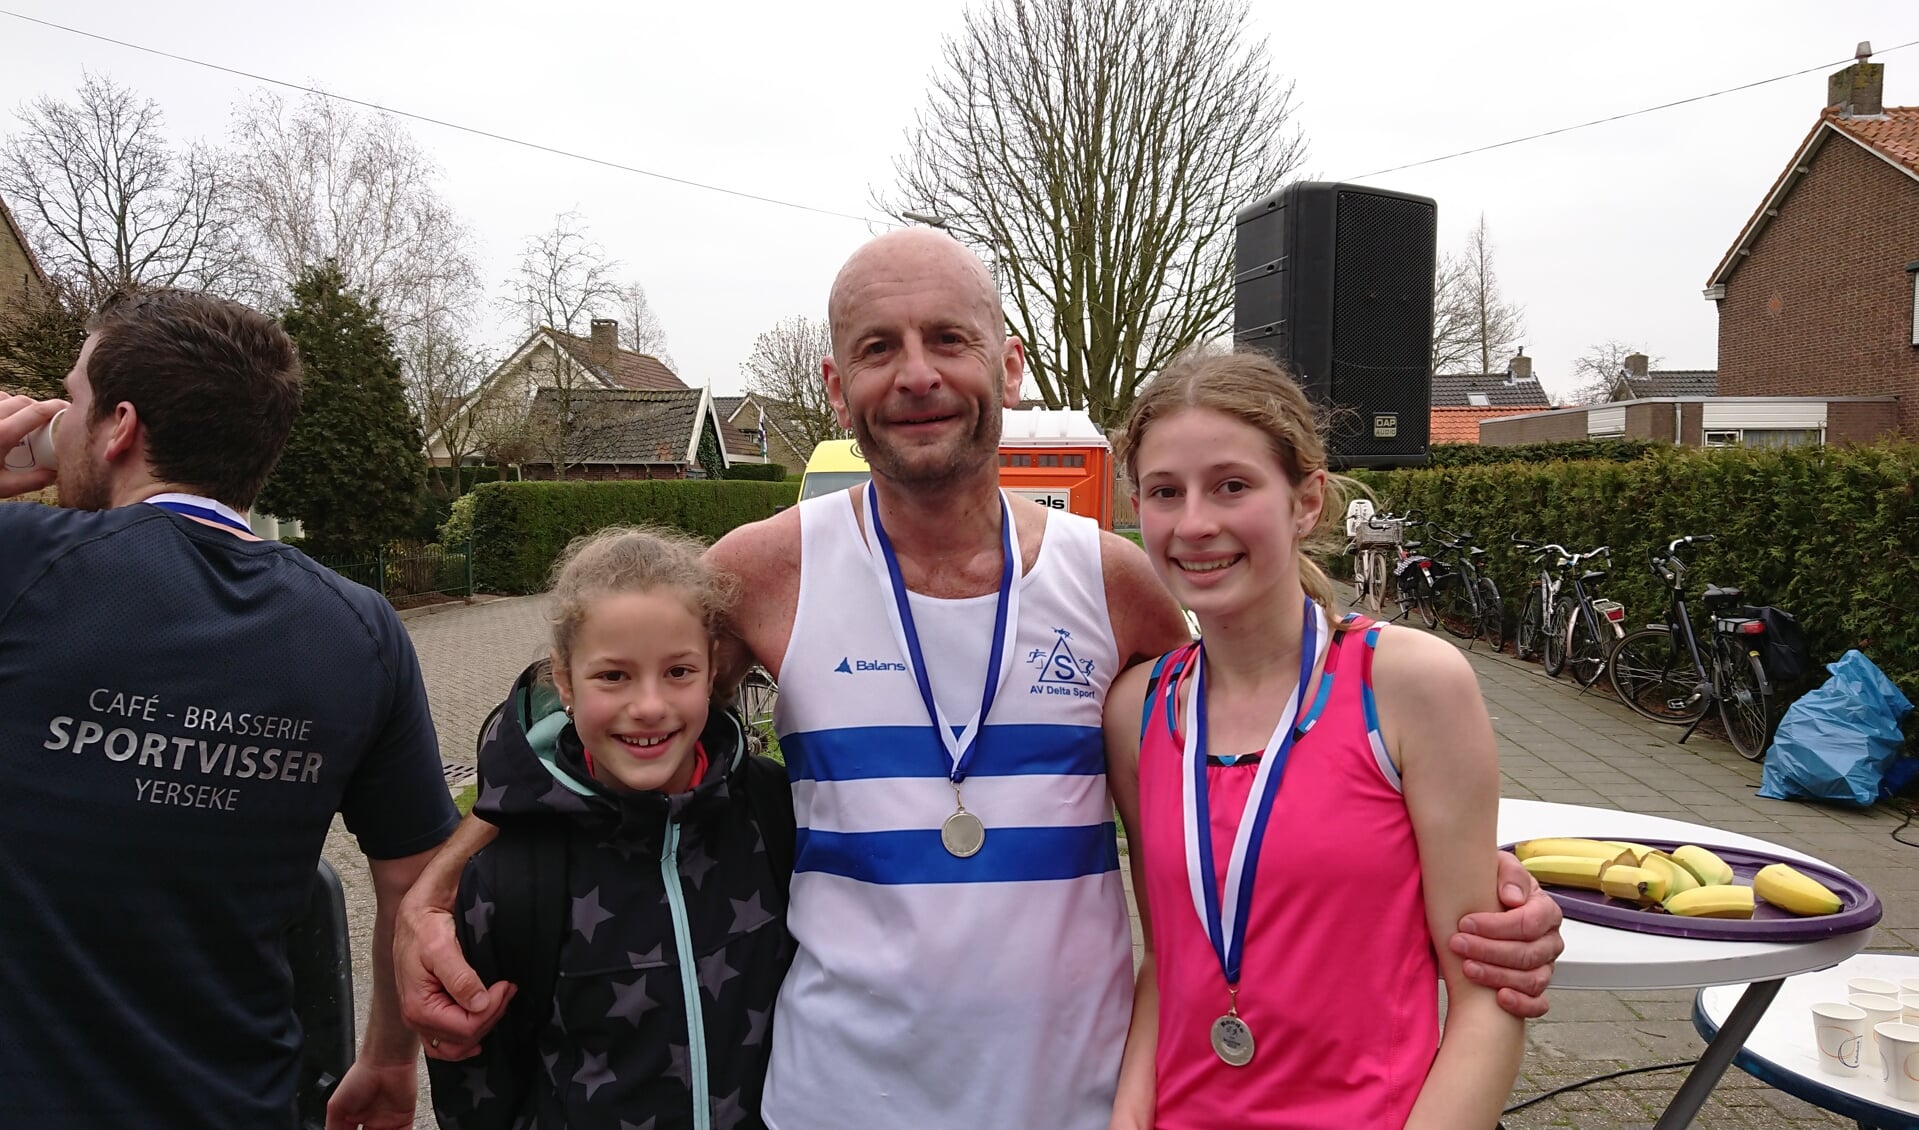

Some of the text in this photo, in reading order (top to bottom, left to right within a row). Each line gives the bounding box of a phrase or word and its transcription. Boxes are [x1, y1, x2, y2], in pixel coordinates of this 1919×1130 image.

[1376, 419, 1396, 427] DAP
[856, 660, 906, 671] Balans
[1054, 655, 1075, 680] S
[1030, 686, 1095, 699] AV Delta Sport
[88, 688, 160, 722] CAFÉ
[183, 706, 313, 741] BRASSERIE
[43, 716, 324, 784] SPORTVISSER
[135, 778, 241, 811] YERSEKE
